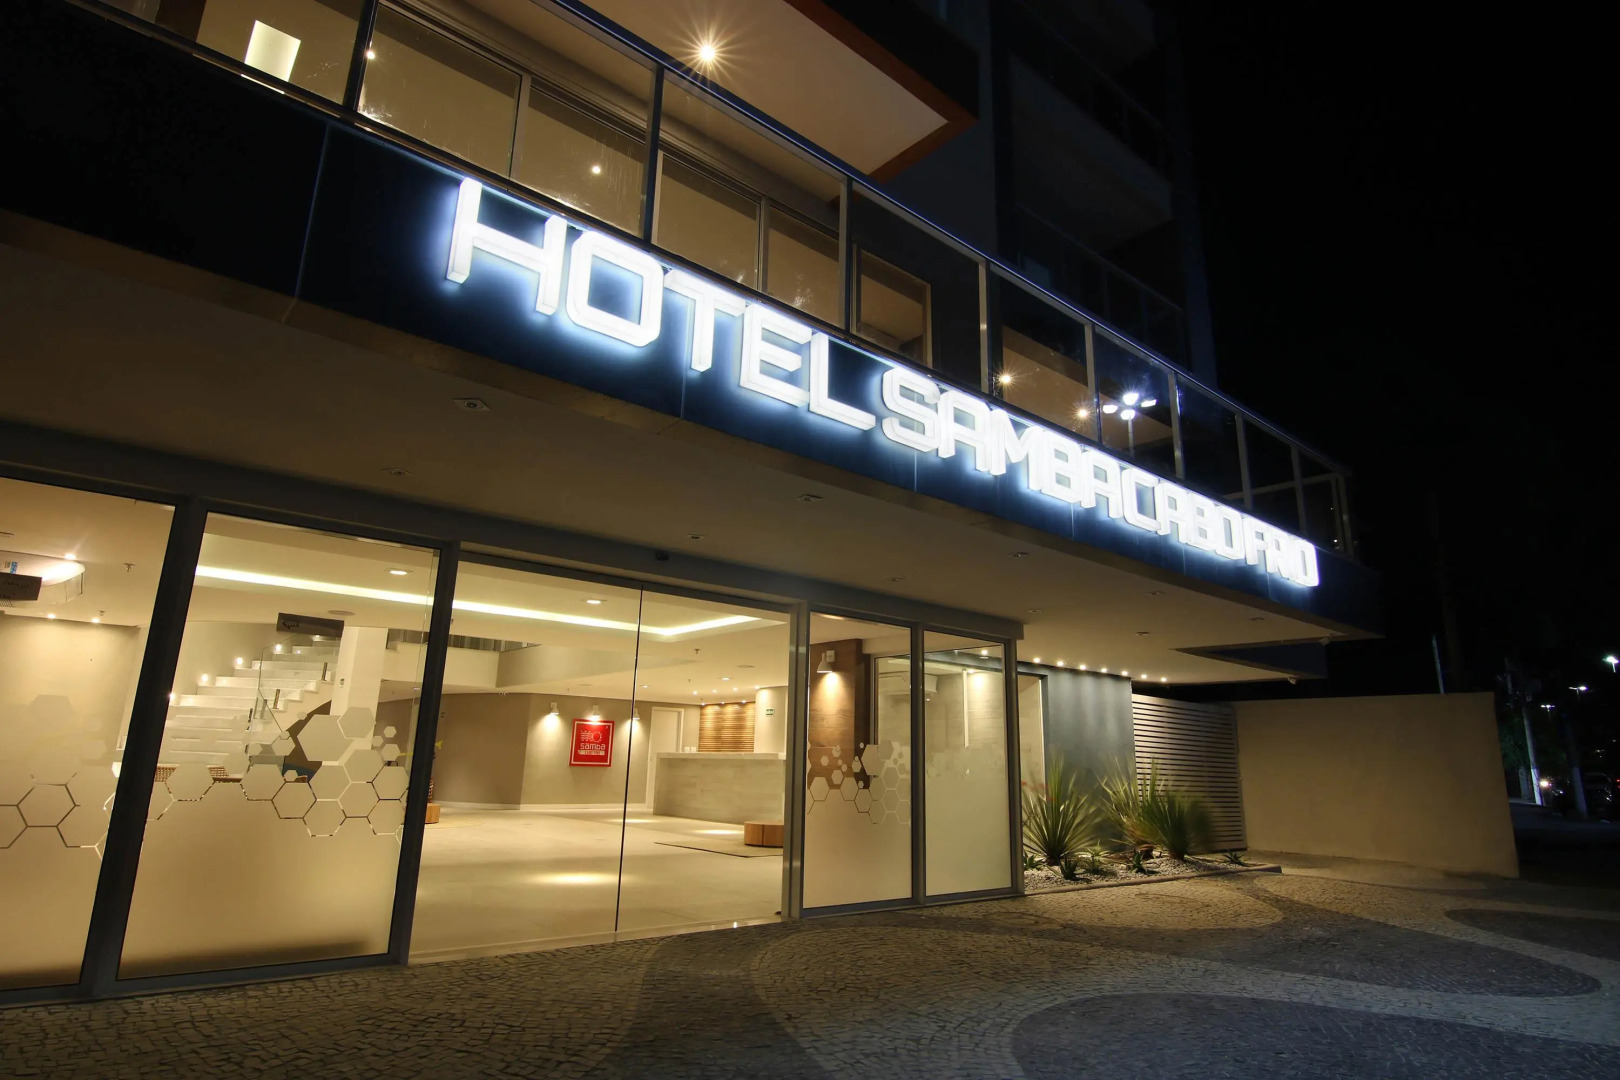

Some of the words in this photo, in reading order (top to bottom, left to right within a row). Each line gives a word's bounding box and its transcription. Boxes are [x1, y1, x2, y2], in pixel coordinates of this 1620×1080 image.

[446, 177, 876, 431] HOTEL
[881, 366, 1124, 518] SAMBA
[1121, 467, 1246, 560] CABO
[1243, 514, 1320, 587] FRIO
[580, 742, 606, 750] samba
